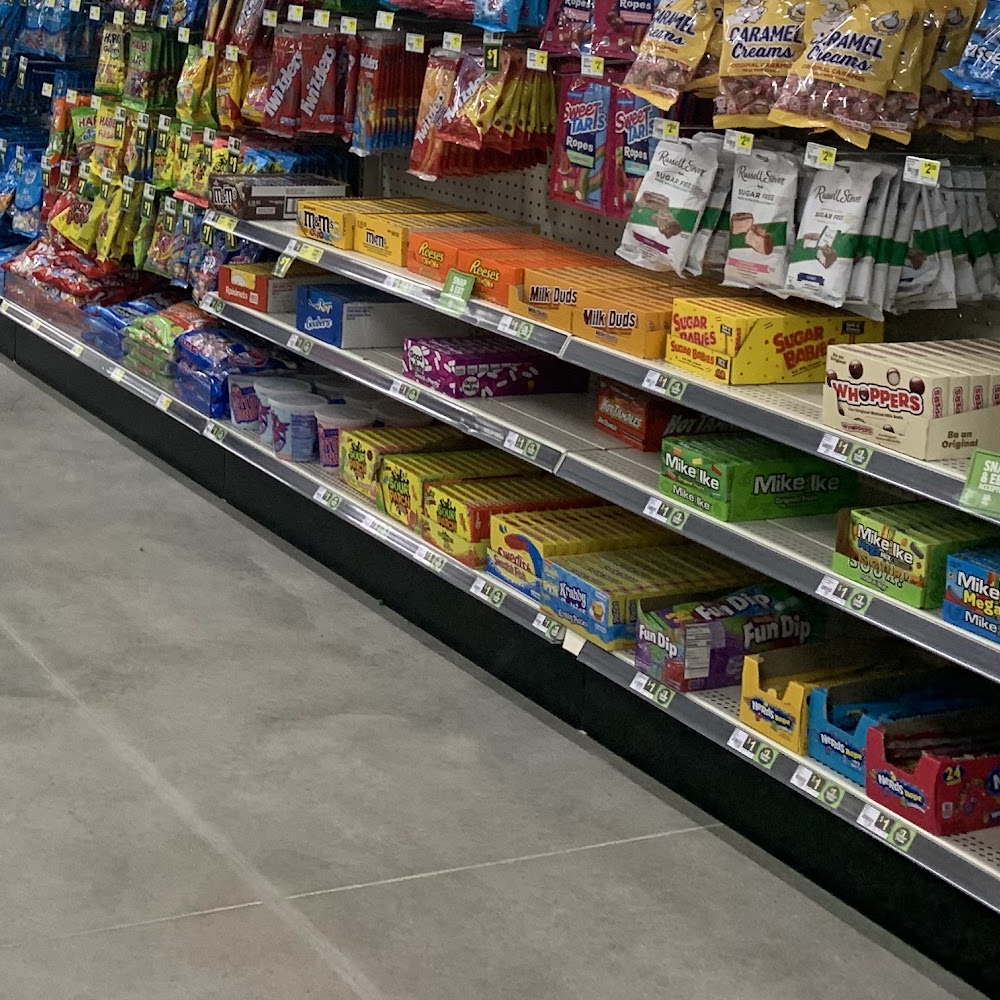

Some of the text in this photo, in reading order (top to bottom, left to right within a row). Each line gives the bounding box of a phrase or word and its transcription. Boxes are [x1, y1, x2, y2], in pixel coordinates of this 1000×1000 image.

[729, 25, 804, 43] CARAMEL
[488, 49, 497, 68] $1
[732, 43, 795, 59] Creams
[807, 46, 872, 71] Creams
[566, 136, 593, 152] Ropes
[624, 146, 648, 160] Ropes
[658, 151, 684, 167] Russell
[656, 172, 679, 184] SUGAR
[737, 166, 765, 181] Russell
[738, 189, 761, 198] SUGAR
[815, 185, 842, 202] Russell
[281, 256, 290, 271] $1
[530, 287, 577, 304] Milk Duds
[583, 310, 637, 327] Milk Duds
[673, 313, 707, 331] SUGAR
[773, 326, 824, 353] SUGAR
[671, 341, 715, 365] SUGAR BABIES
[659, 376, 667, 387] $1
[832, 382, 920, 411] WHOPPERS
[839, 443, 848, 454] $1
[942, 439, 978, 449] Original
[665, 453, 719, 490] Mike Ike
[754, 474, 840, 494] Mike Ike
[673, 485, 710, 510] Mike Ike
[661, 504, 668, 517] $1
[857, 524, 889, 550] Mike
[893, 543, 913, 564] Ike
[838, 585, 848, 598] $1
[958, 571, 999, 599] Mike
[560, 582, 587, 607] Krabby
[695, 593, 771, 620] Fun Dip
[965, 610, 998, 633] Mike
[744, 615, 810, 649] Fun Dip
[639, 625, 677, 657] Fun Dip
[648, 680, 654, 692] $1
[749, 738, 757, 751] $1
[812, 776, 820, 789] $1
[944, 766, 961, 782] 24
[880, 816, 889, 830] $1
